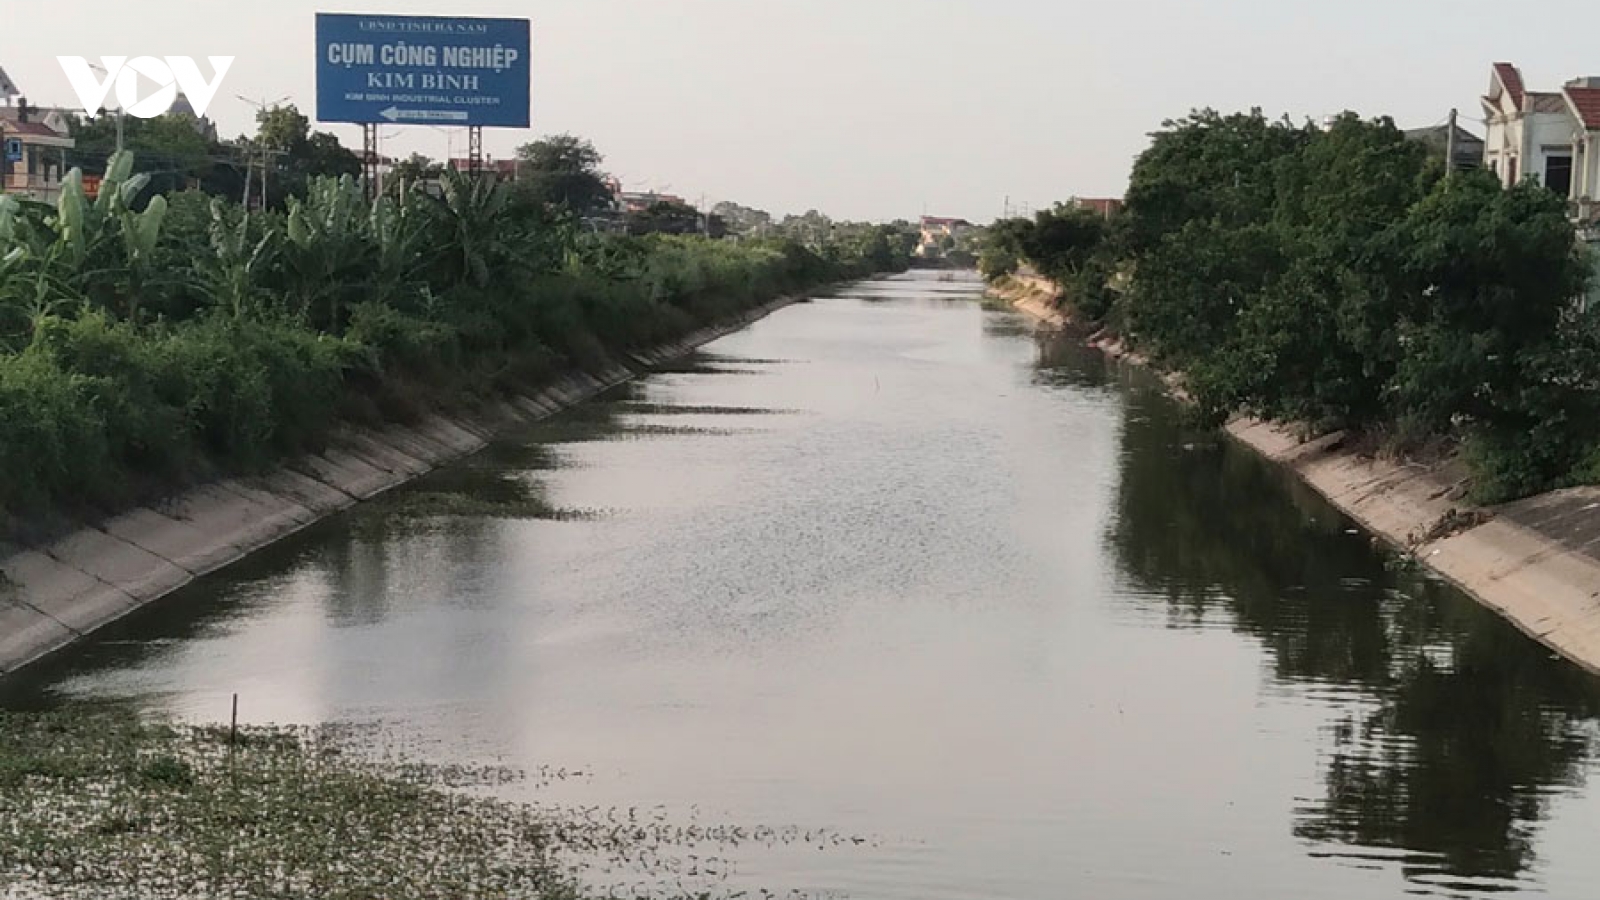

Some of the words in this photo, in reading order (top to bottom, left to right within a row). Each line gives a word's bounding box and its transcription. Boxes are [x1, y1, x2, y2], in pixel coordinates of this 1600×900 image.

[457, 24, 487, 33] NAM
[328, 43, 374, 68] CỤM
[381, 41, 437, 67] CÔNG
[443, 43, 518, 73] NGHIỆP
[367, 73, 414, 88] KIM
[421, 70, 479, 90] BÌNH
[345, 93, 363, 101] KIM
[393, 94, 451, 104] INDUSTRIAL
[454, 96, 500, 105] CLUSTER
